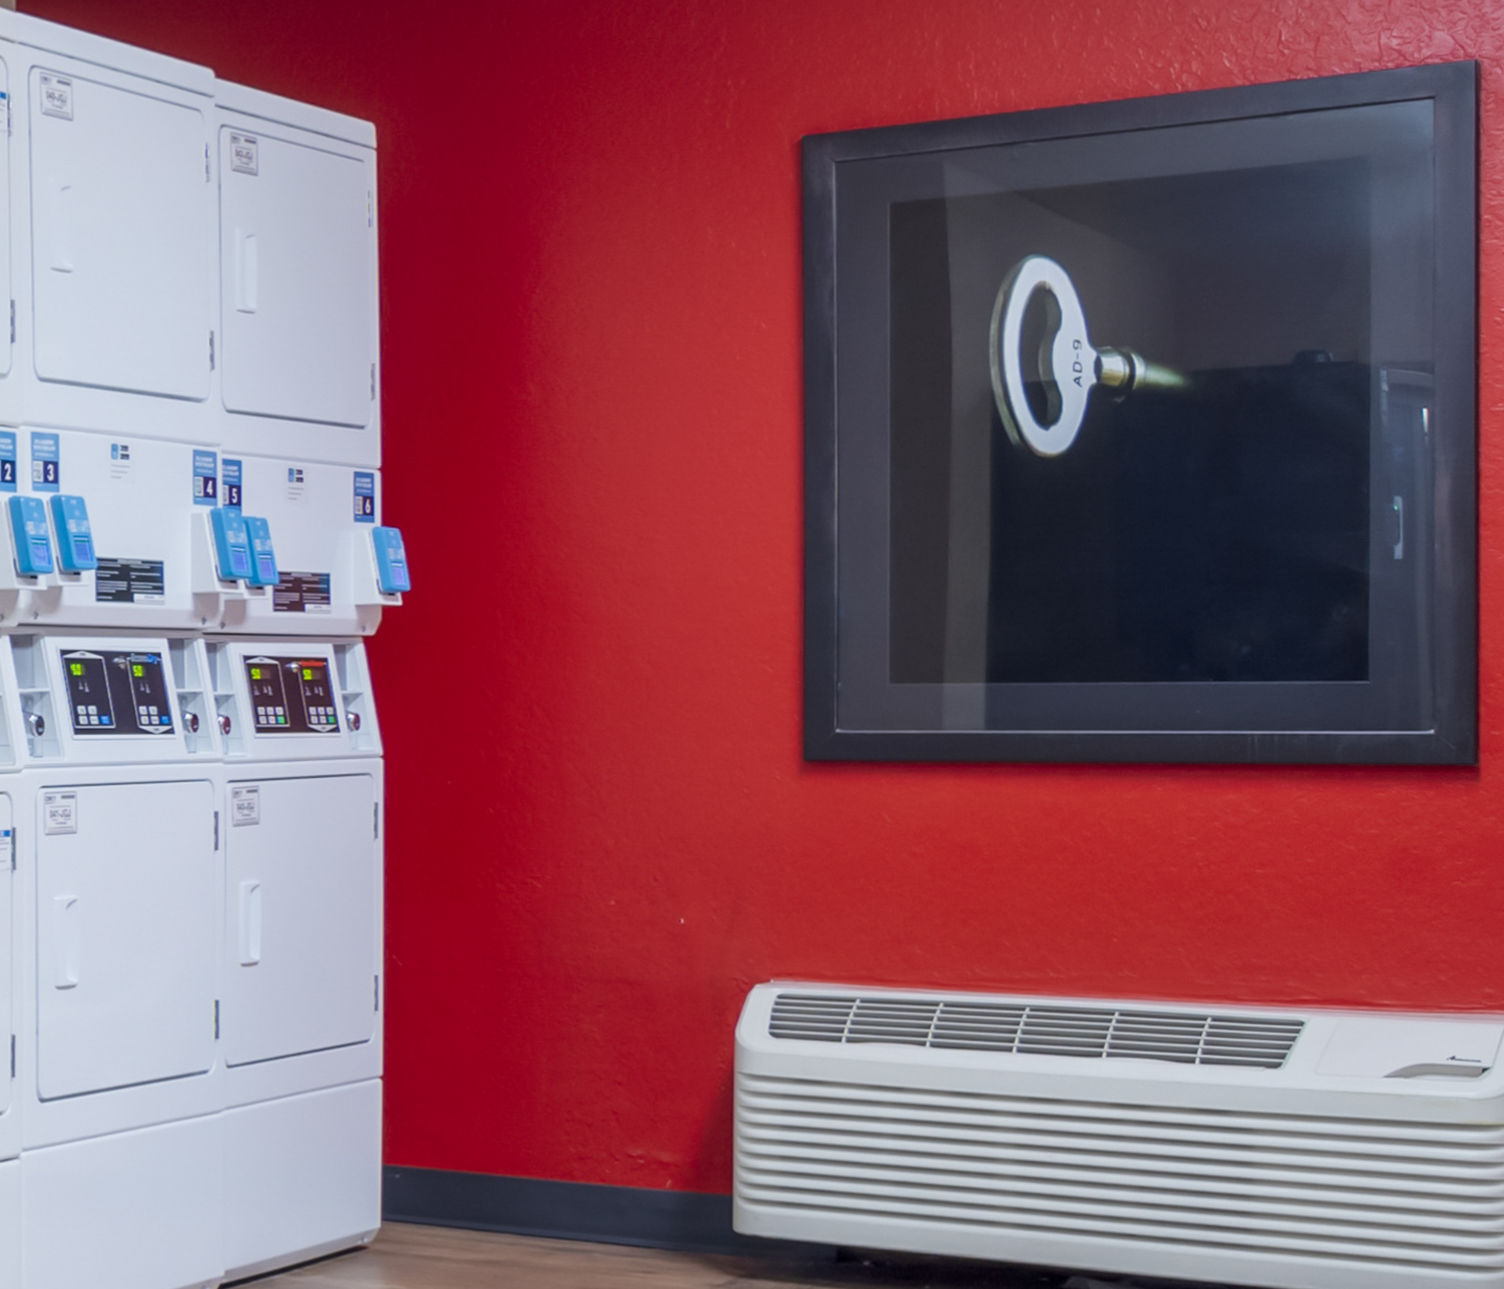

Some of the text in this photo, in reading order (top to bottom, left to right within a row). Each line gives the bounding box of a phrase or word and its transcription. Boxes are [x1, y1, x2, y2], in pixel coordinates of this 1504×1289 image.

[4, 463, 11, 481] 2
[47, 463, 54, 481] 3
[206, 480, 213, 496] 4
[231, 487, 237, 504] 5
[365, 498, 371, 514] 6
